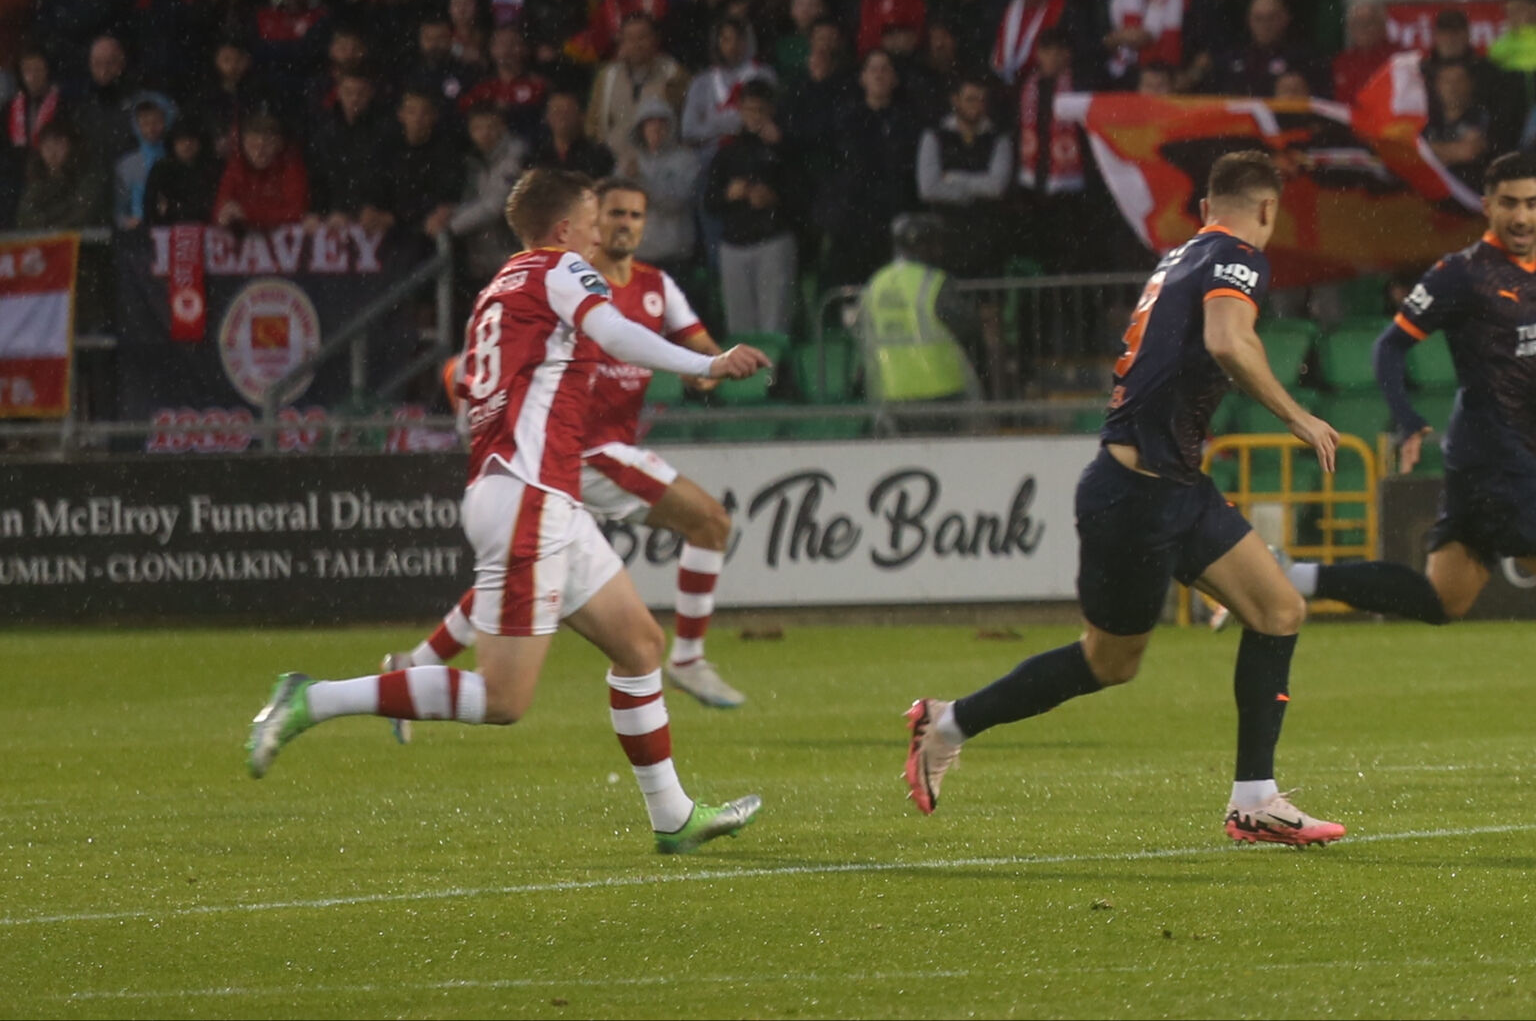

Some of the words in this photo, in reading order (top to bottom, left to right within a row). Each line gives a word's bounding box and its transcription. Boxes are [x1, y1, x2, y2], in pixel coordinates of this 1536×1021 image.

[33, 495, 180, 545] McElroy
[190, 492, 318, 532] Funeral
[750, 468, 861, 569] The
[868, 468, 1047, 570] Bank
[106, 550, 293, 584] CLONDALKIN
[314, 545, 463, 577] TALLAGHT
